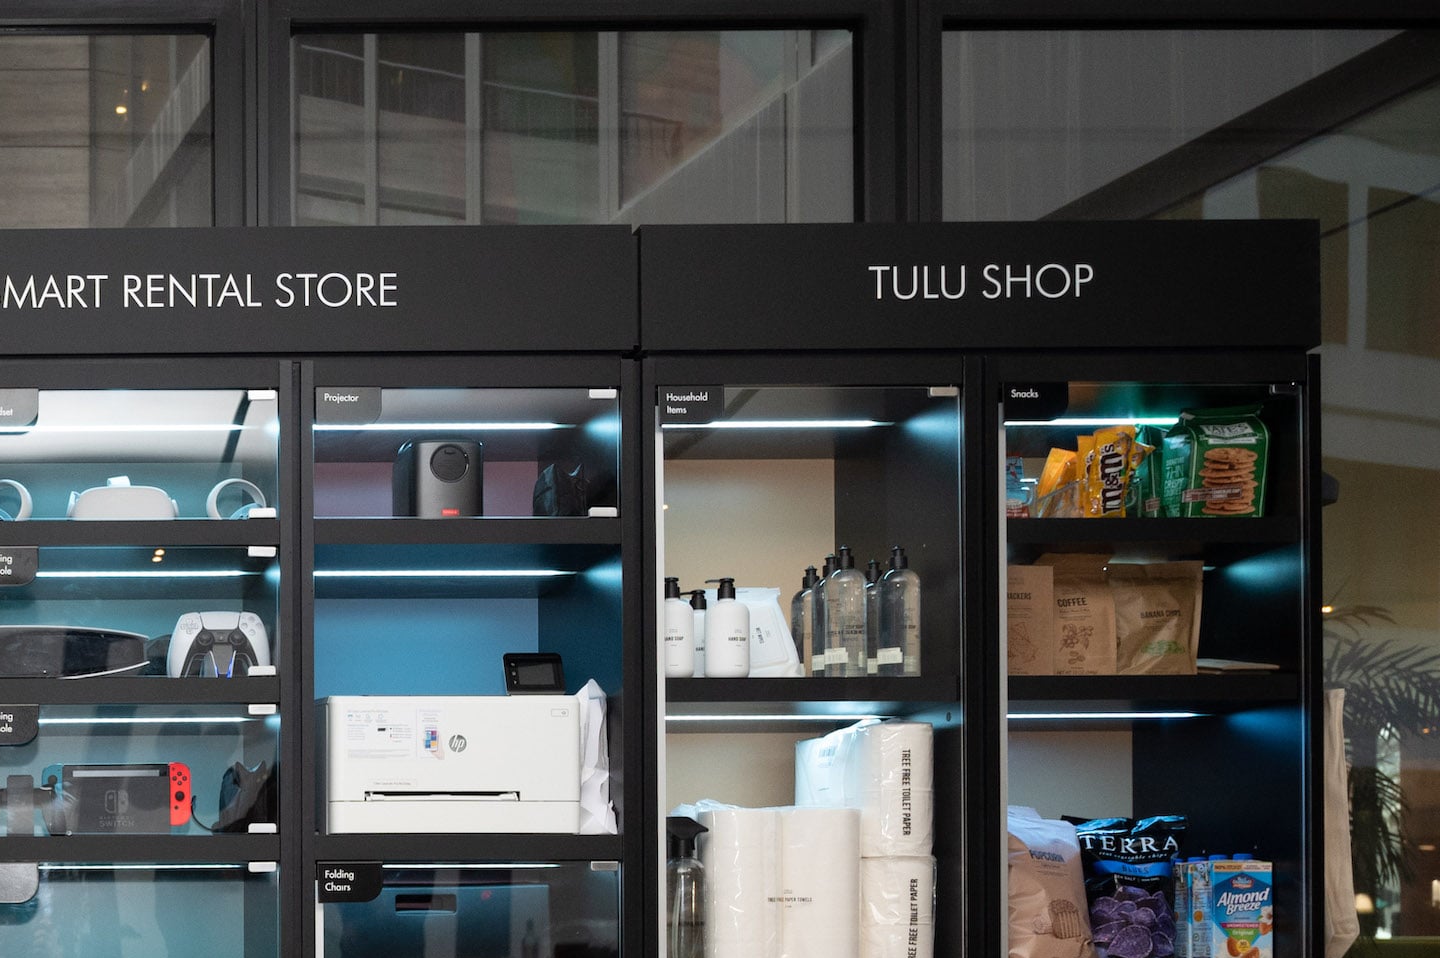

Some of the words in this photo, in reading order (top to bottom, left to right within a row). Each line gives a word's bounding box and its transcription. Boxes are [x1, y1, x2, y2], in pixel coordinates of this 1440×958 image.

[123, 273, 263, 308] RENTAL
[275, 272, 397, 308] STORE
[867, 265, 966, 300] TULU
[982, 263, 1094, 299] SHOP
[323, 392, 360, 404] Projector
[665, 391, 709, 402] Household
[1010, 388, 1039, 399] Snacks
[666, 405, 687, 415] Items
[1056, 597, 1088, 608] COFFEE
[449, 734, 467, 753] hp
[902, 748, 911, 767] TREE
[902, 768, 911, 786] FREE
[902, 787, 911, 812] TOILET
[902, 813, 911, 836] PAPER
[1079, 833, 1179, 854] TERRA
[324, 868, 355, 880] Folding
[1122, 865, 1150, 874] BLUES
[324, 881, 353, 892] Chairs
[910, 878, 919, 900] PAPER
[1217, 888, 1270, 907] Almond
[909, 901, 918, 925] TOILET
[1226, 901, 1262, 915] Breeze
[908, 926, 918, 946] FREE
